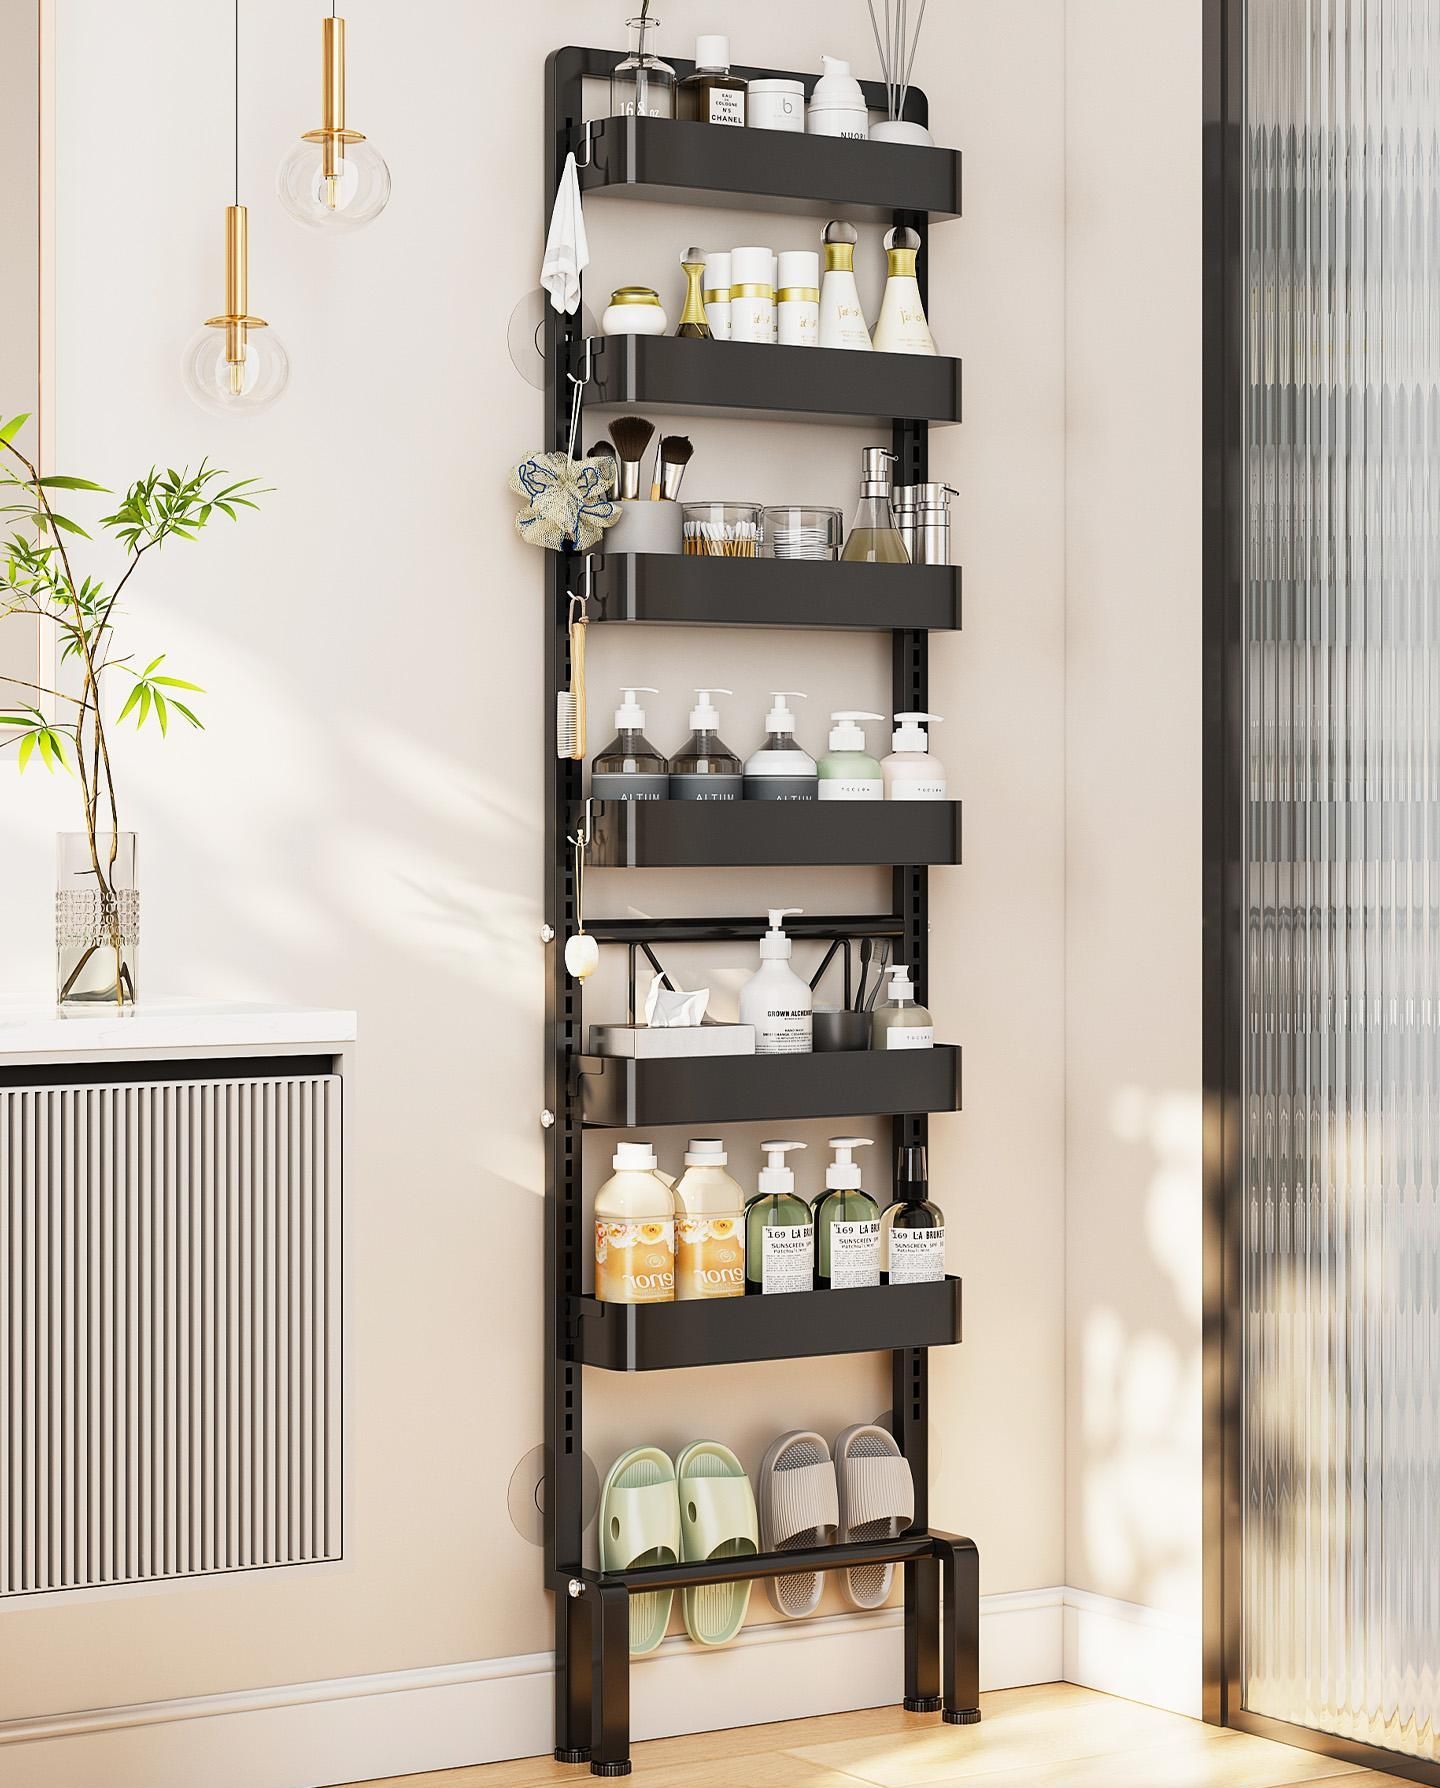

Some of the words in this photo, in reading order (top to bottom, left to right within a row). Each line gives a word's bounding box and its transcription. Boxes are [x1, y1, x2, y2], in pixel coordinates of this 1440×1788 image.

[711, 114, 743, 124] CHANEL
[835, 1226, 854, 1235] 169
[767, 1231, 786, 1239] 169
[893, 1232, 908, 1240] 169
